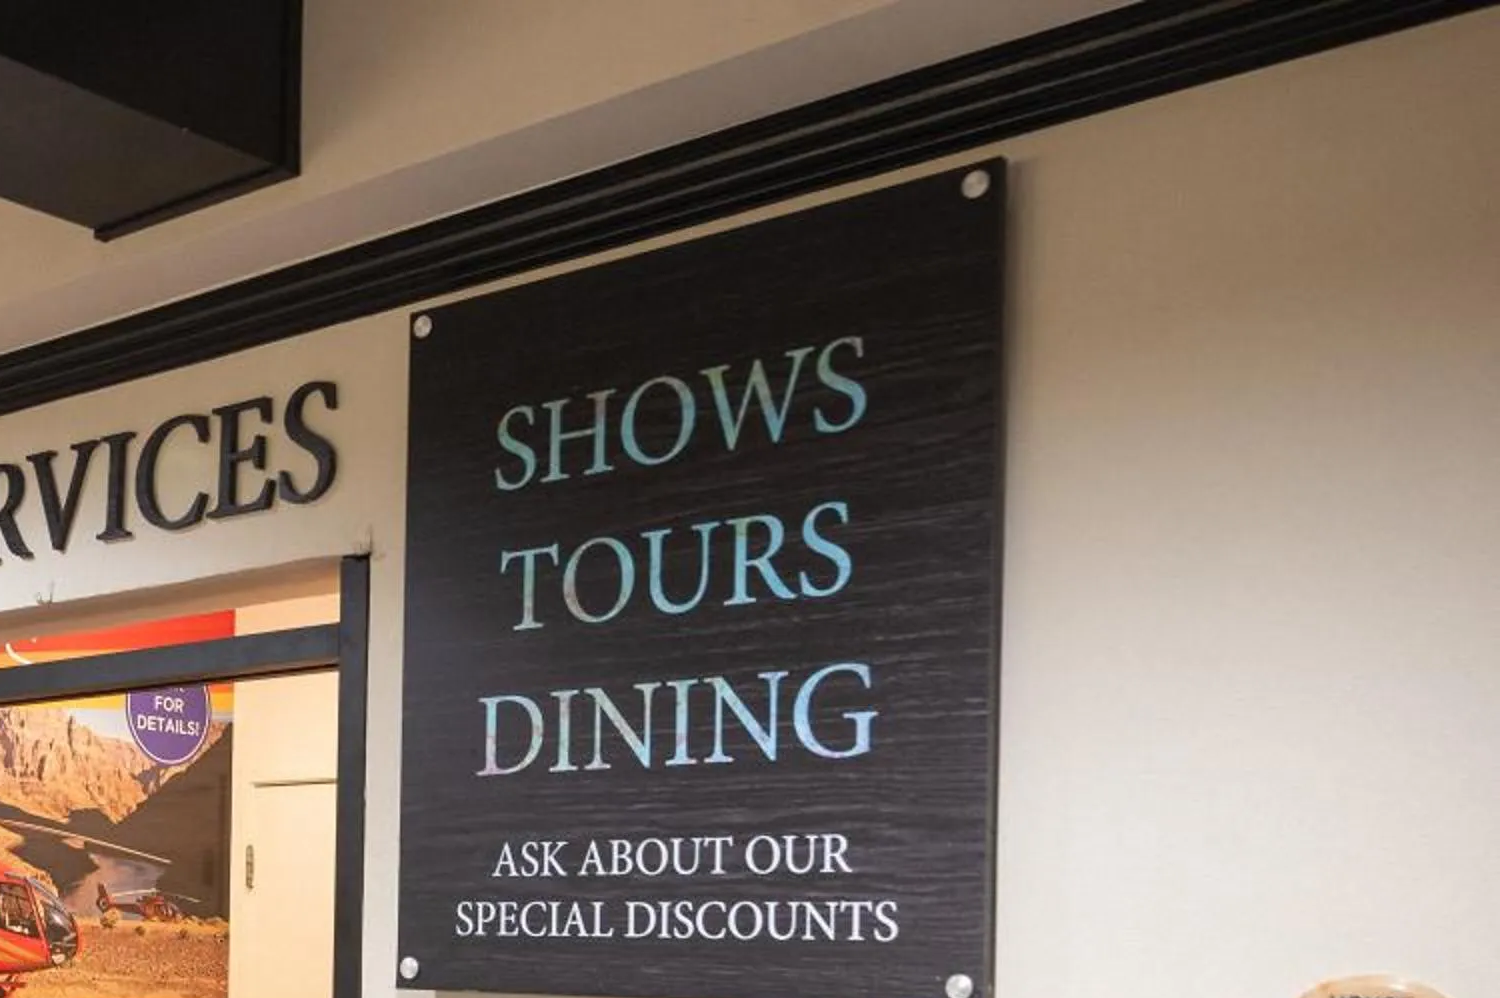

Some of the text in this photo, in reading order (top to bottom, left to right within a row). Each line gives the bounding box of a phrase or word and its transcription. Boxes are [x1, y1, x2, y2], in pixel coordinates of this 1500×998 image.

[494, 336, 869, 491] SHOWS
[501, 501, 854, 632] TOURS
[137, 713, 200, 738] DETAILS!
[154, 696, 185, 712] FOR
[475, 663, 879, 777] DINING
[492, 833, 854, 879] ASK ABOUT OUR
[455, 900, 900, 944] SPECIAL DISCOUNTS
